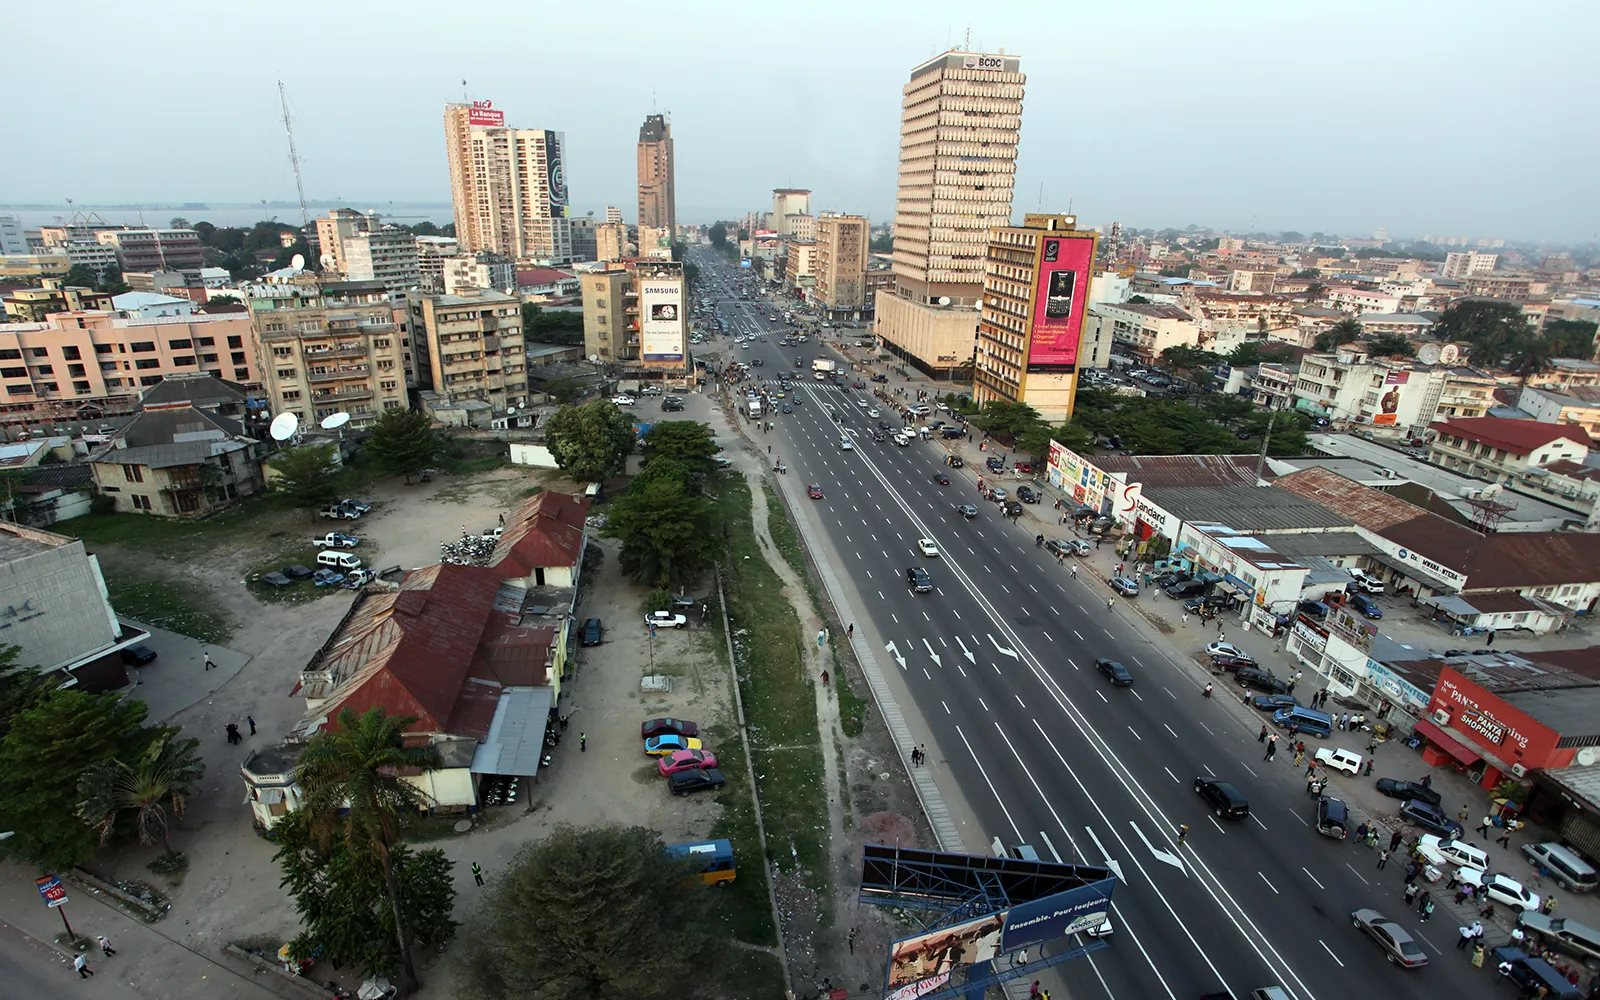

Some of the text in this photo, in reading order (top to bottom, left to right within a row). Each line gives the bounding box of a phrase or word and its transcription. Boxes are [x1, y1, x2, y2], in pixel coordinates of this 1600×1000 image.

[978, 58, 1002, 68] BCDC
[1122, 486, 1166, 526] Standard
[1366, 659, 1390, 676] BABY
[1398, 679, 1430, 706] CENTER
[1451, 690, 1479, 709] PANTA
[1461, 714, 1500, 744] SHOPPING
[1477, 716, 1502, 737] PANTA
[1010, 898, 1109, 930] Ensemble. Pour toujours.
